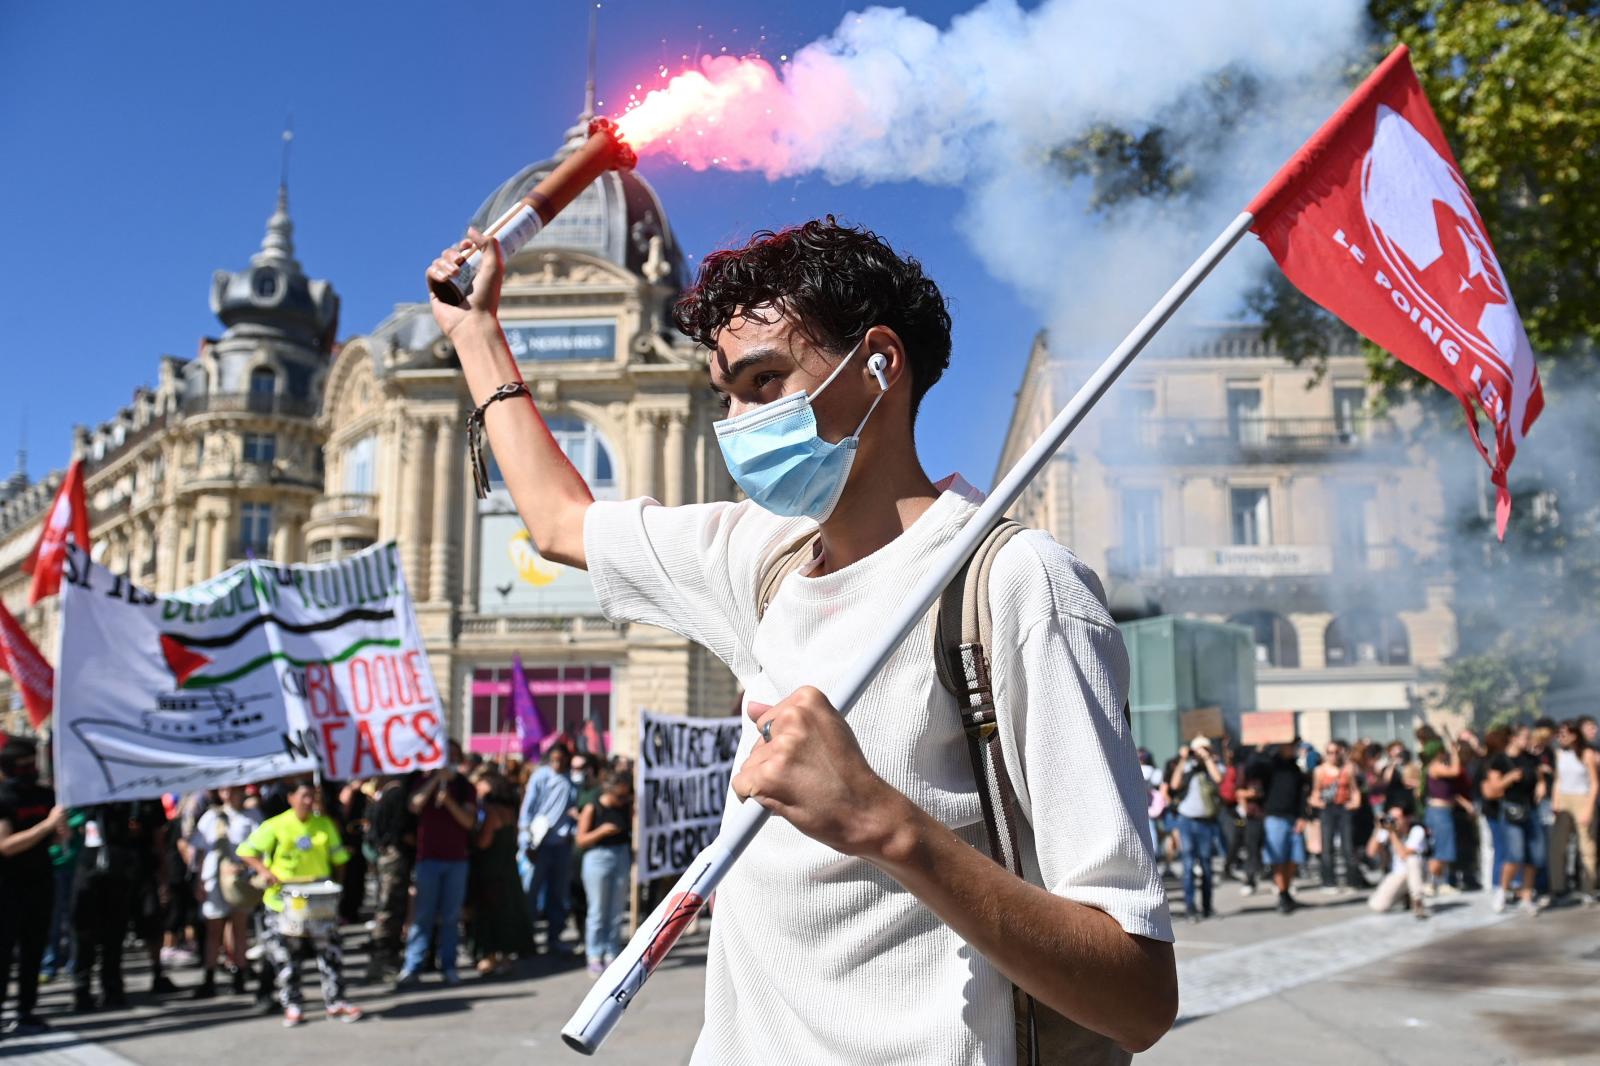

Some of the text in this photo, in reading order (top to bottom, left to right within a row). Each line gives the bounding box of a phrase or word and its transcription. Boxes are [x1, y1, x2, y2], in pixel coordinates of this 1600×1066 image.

[1333, 228, 1366, 265] LE
[1374, 270, 1463, 366] POING
[305, 650, 434, 720] BLOQUE
[321, 710, 443, 777] FACS
